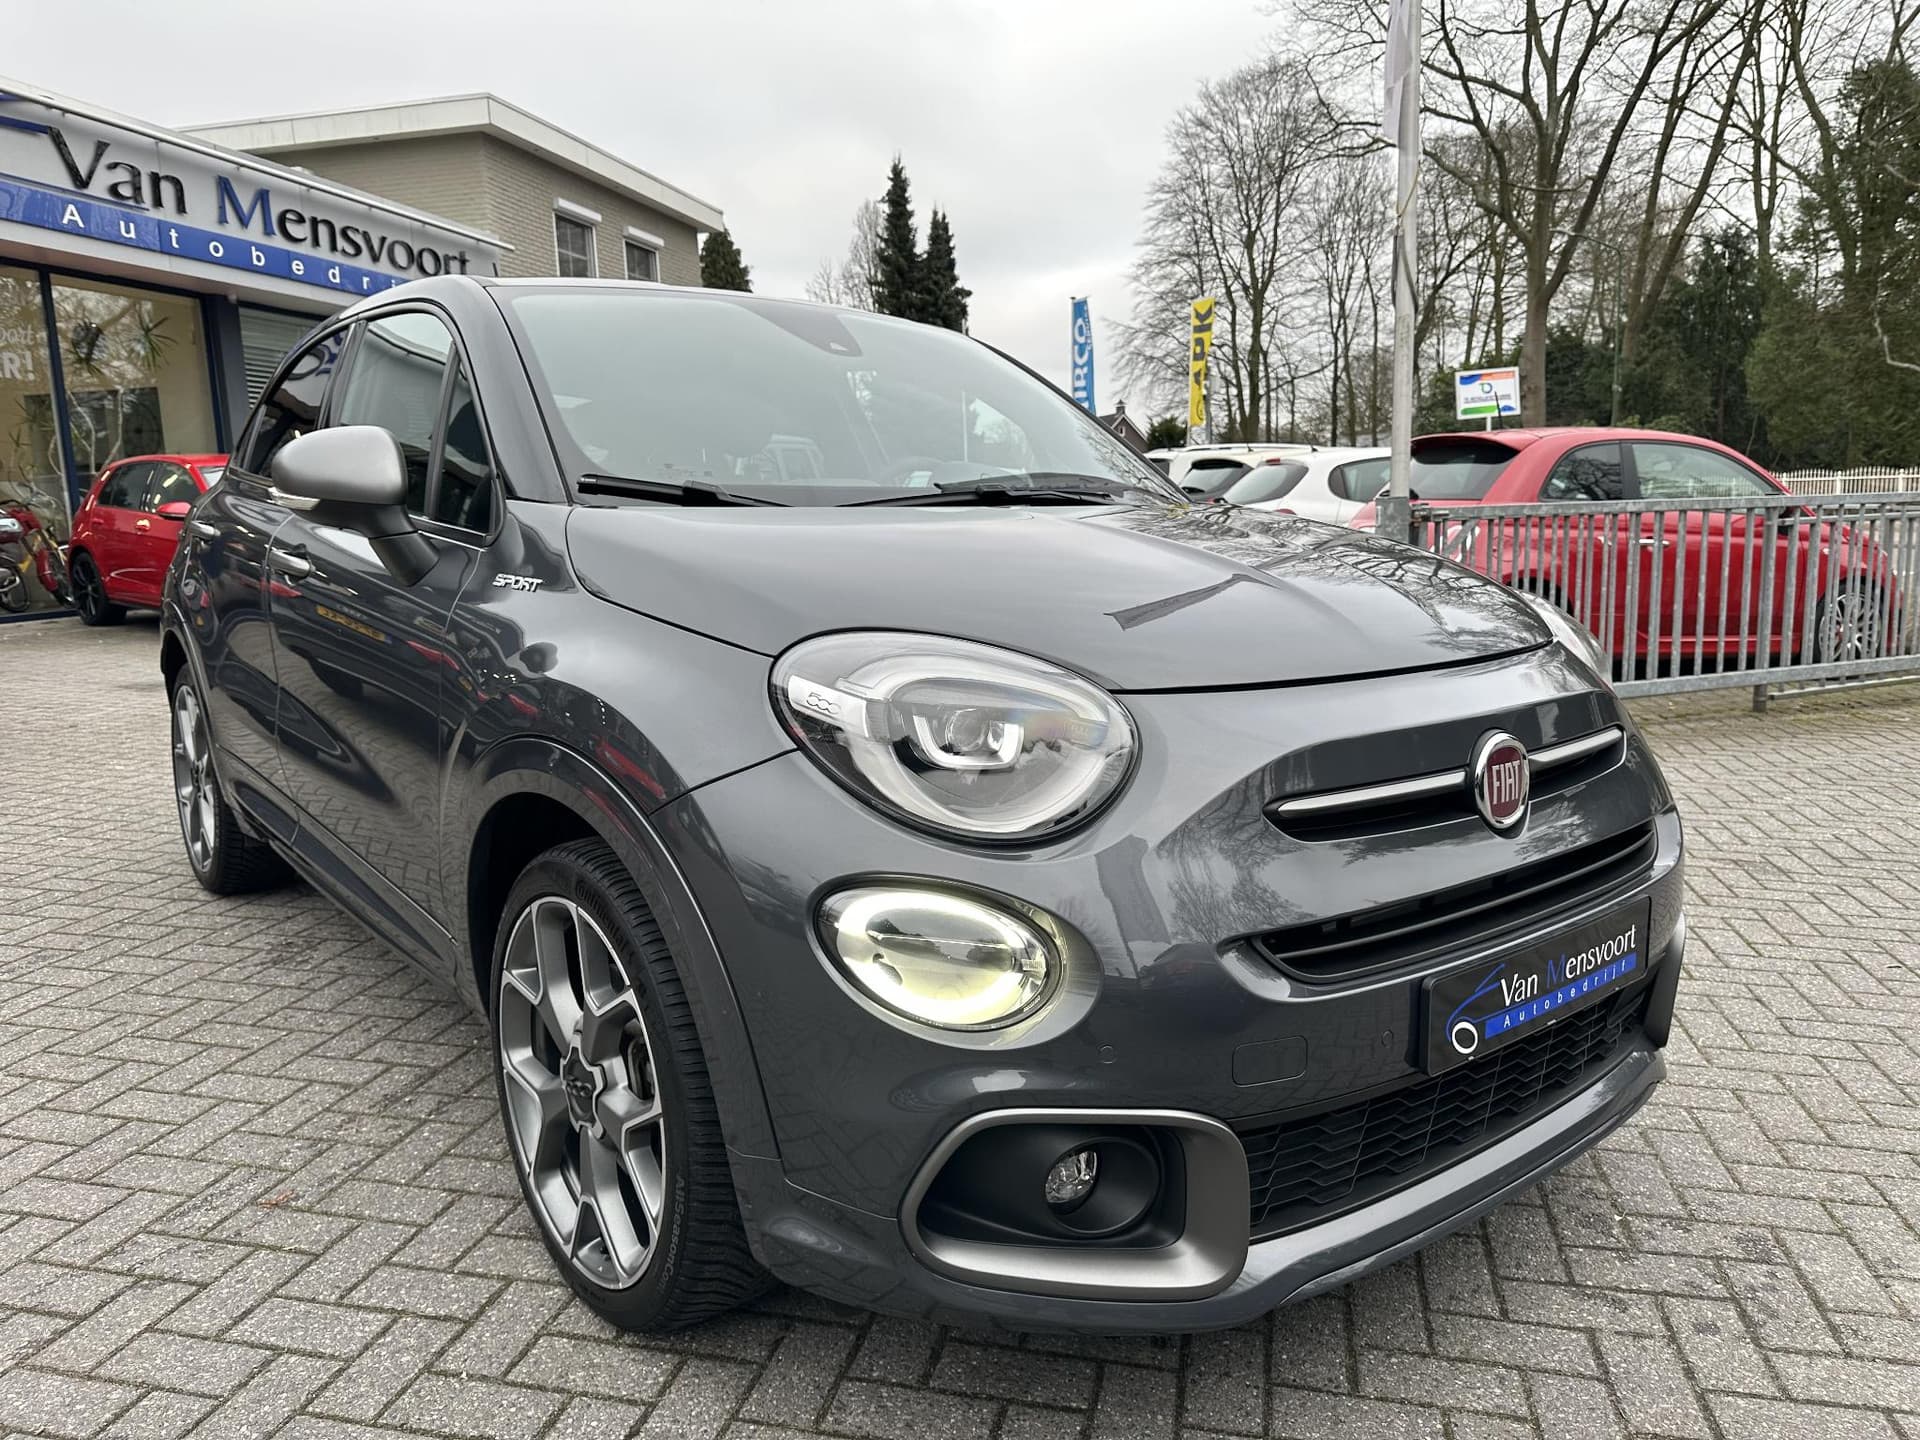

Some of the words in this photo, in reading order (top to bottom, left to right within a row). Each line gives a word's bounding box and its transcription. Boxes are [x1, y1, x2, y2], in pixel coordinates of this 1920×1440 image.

[49, 126, 187, 215] Van
[217, 175, 470, 277] Mensvoort
[62, 203, 396, 289] Autobedri
[0, 351, 35, 380] R!
[492, 573, 544, 592] SPORT
[806, 692, 841, 715] 500
[1491, 760, 1521, 805] FIAT
[1501, 972, 1538, 1007] Van
[1546, 924, 1637, 990] Mensvoort
[1503, 959, 1627, 1028] Autobedrijf
